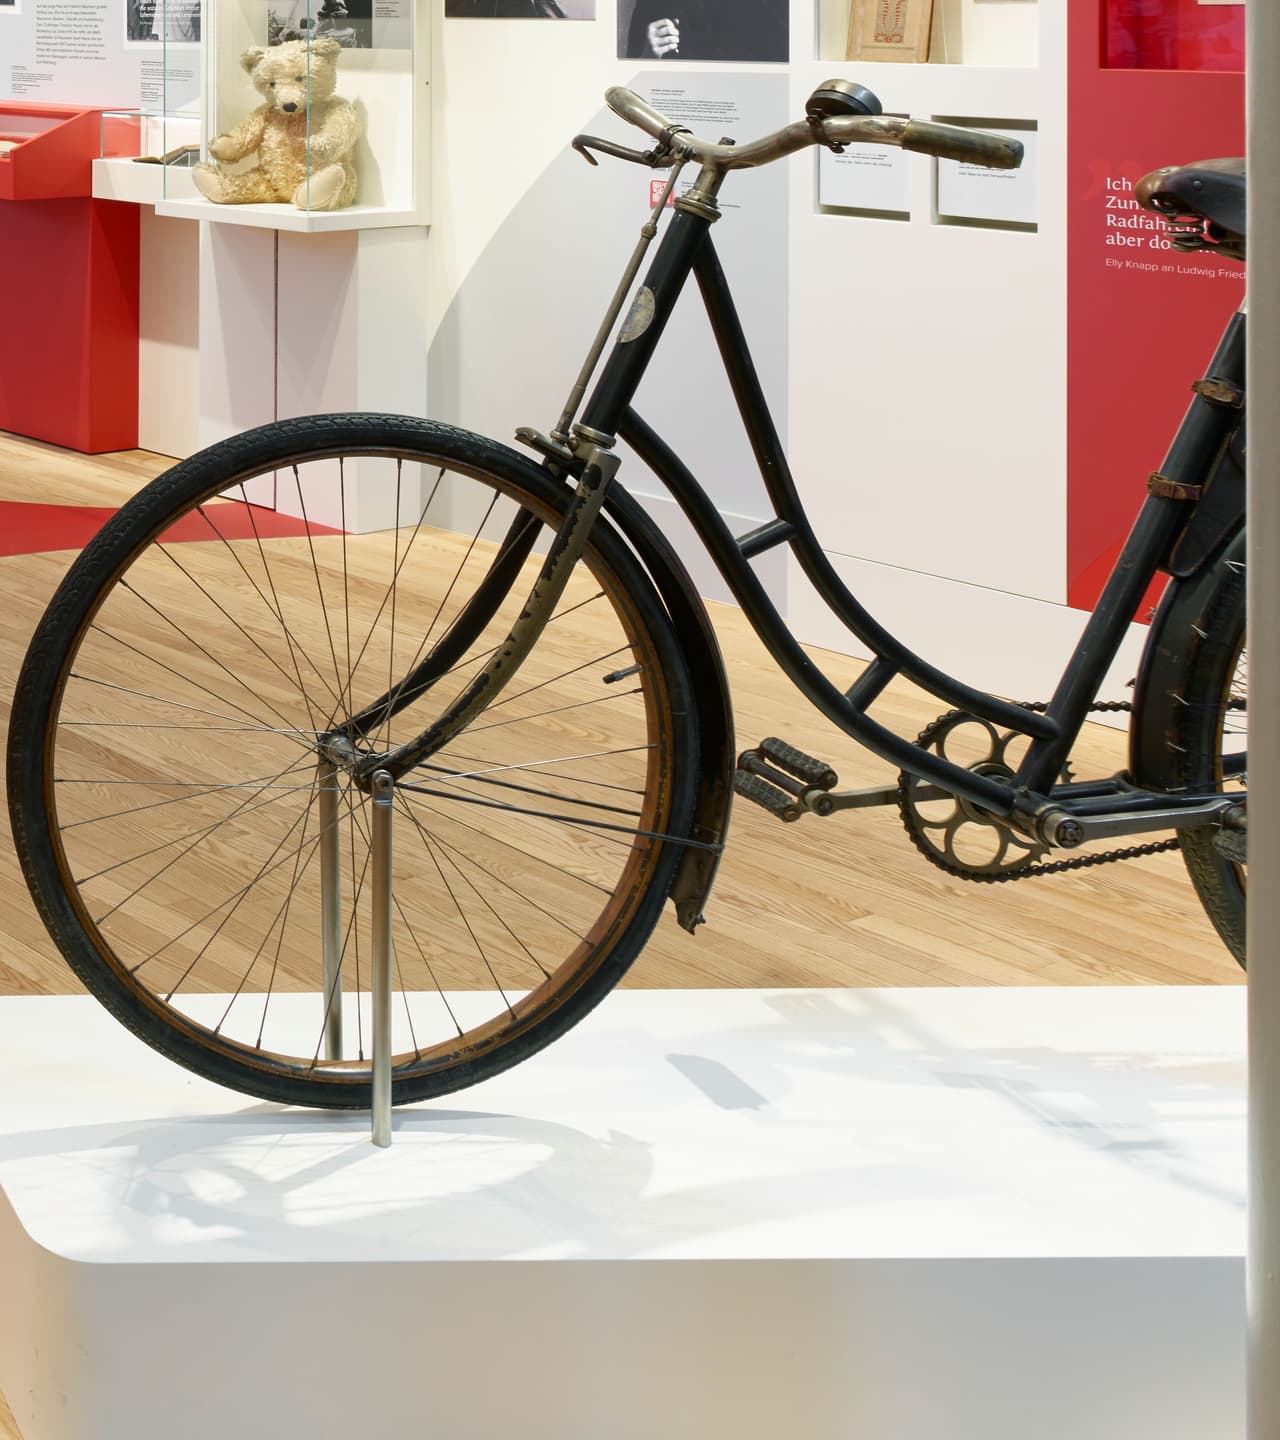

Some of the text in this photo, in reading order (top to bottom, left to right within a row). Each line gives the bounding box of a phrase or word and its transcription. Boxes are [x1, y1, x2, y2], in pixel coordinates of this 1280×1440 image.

[1106, 177, 1132, 191] Ich
[1106, 232, 1144, 248] aber
[1105, 258, 1247, 280] Elly Knapp an Ludwig Fried
